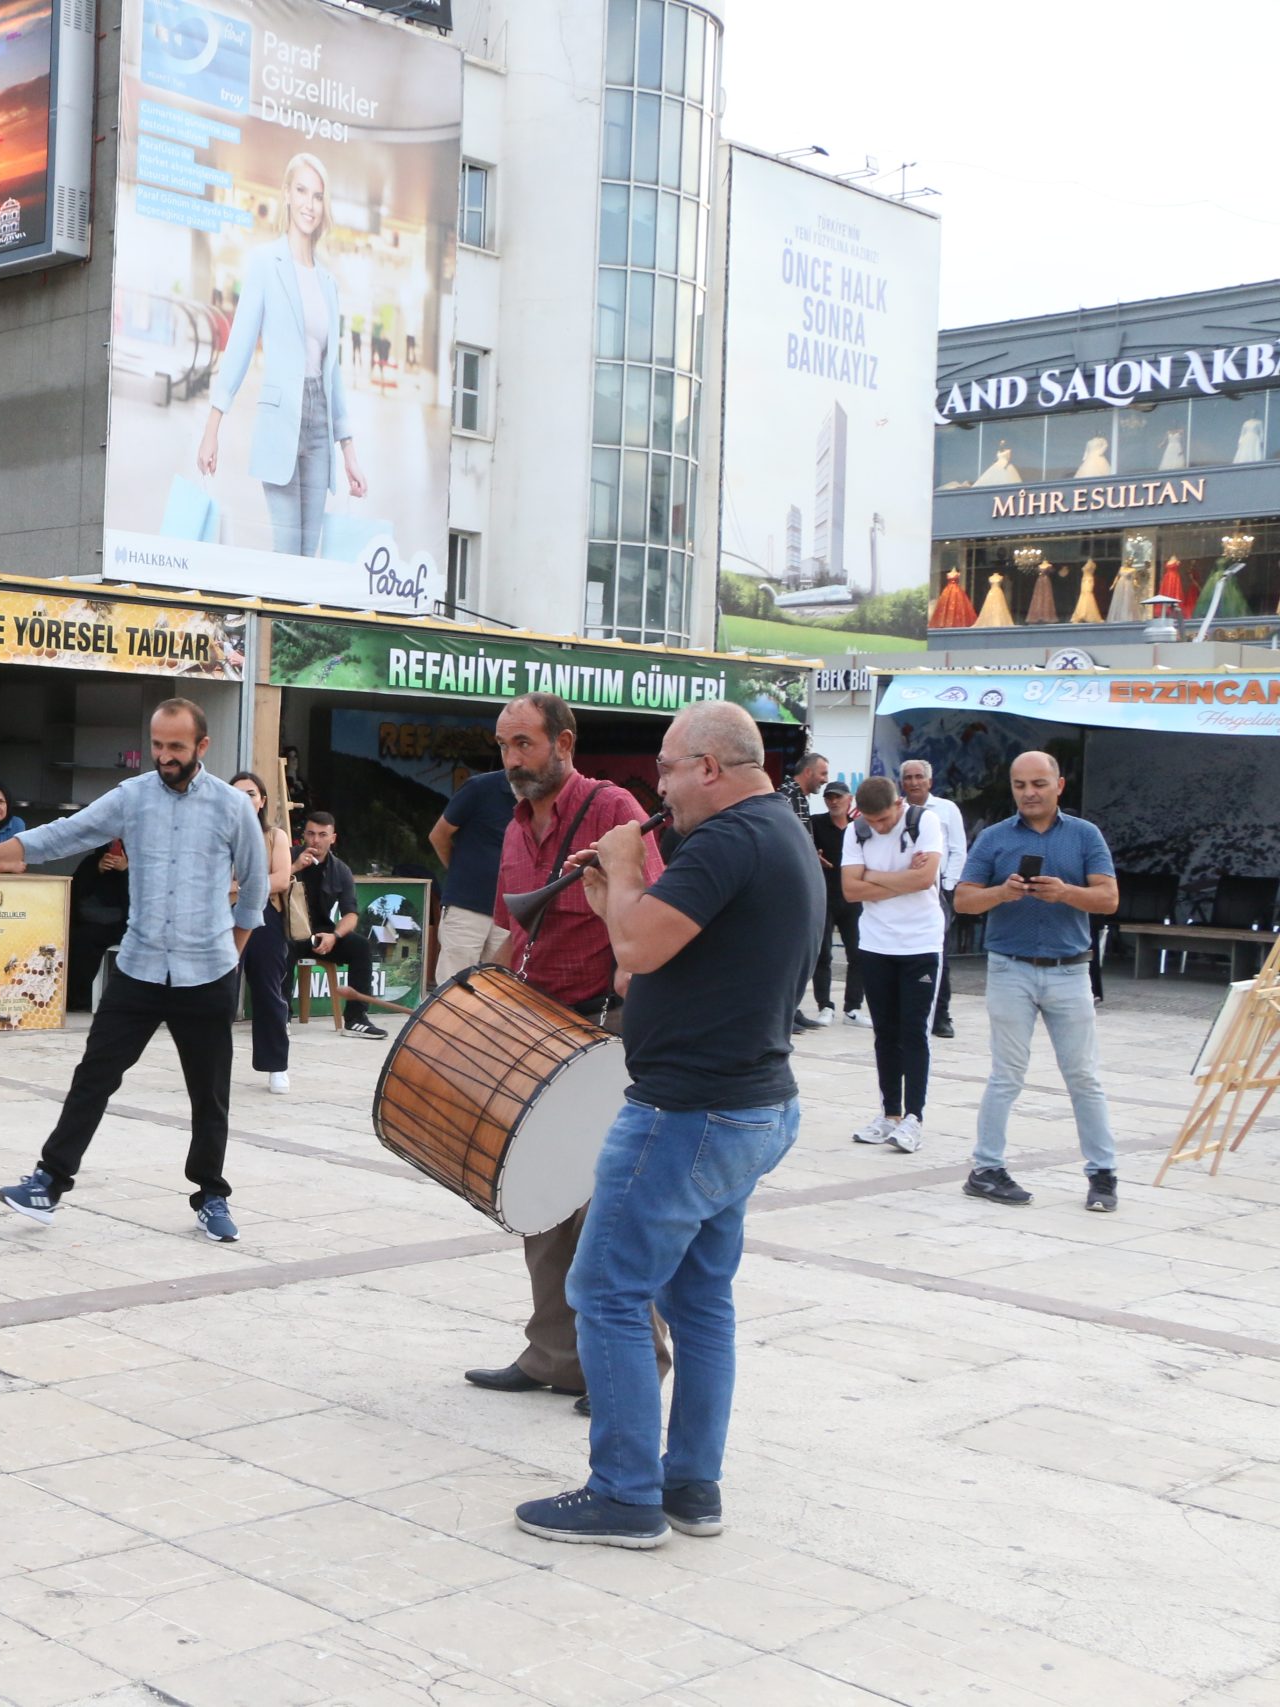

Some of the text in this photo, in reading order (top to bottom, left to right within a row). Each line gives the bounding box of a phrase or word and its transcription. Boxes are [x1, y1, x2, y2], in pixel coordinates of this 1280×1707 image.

[263, 30, 322, 71] Paraf
[220, 87, 244, 108] troy
[262, 65, 379, 119] Güzellikler
[261, 96, 349, 143] Dünyası
[782, 238, 887, 314] ÖNCE HALK
[803, 296, 865, 347] SONRA
[787, 332, 878, 390] BANKAYIZ
[935, 339, 1280, 424] AND SALON AKB
[129, 551, 189, 570] HALKBANK
[14, 610, 118, 655] YÖRESEL
[125, 626, 211, 663] TADLAR
[388, 647, 726, 709] REFAHİYE TANITIM GÜNLERİ
[850, 668, 872, 691] BA
[1024, 677, 1102, 704] 8/24
